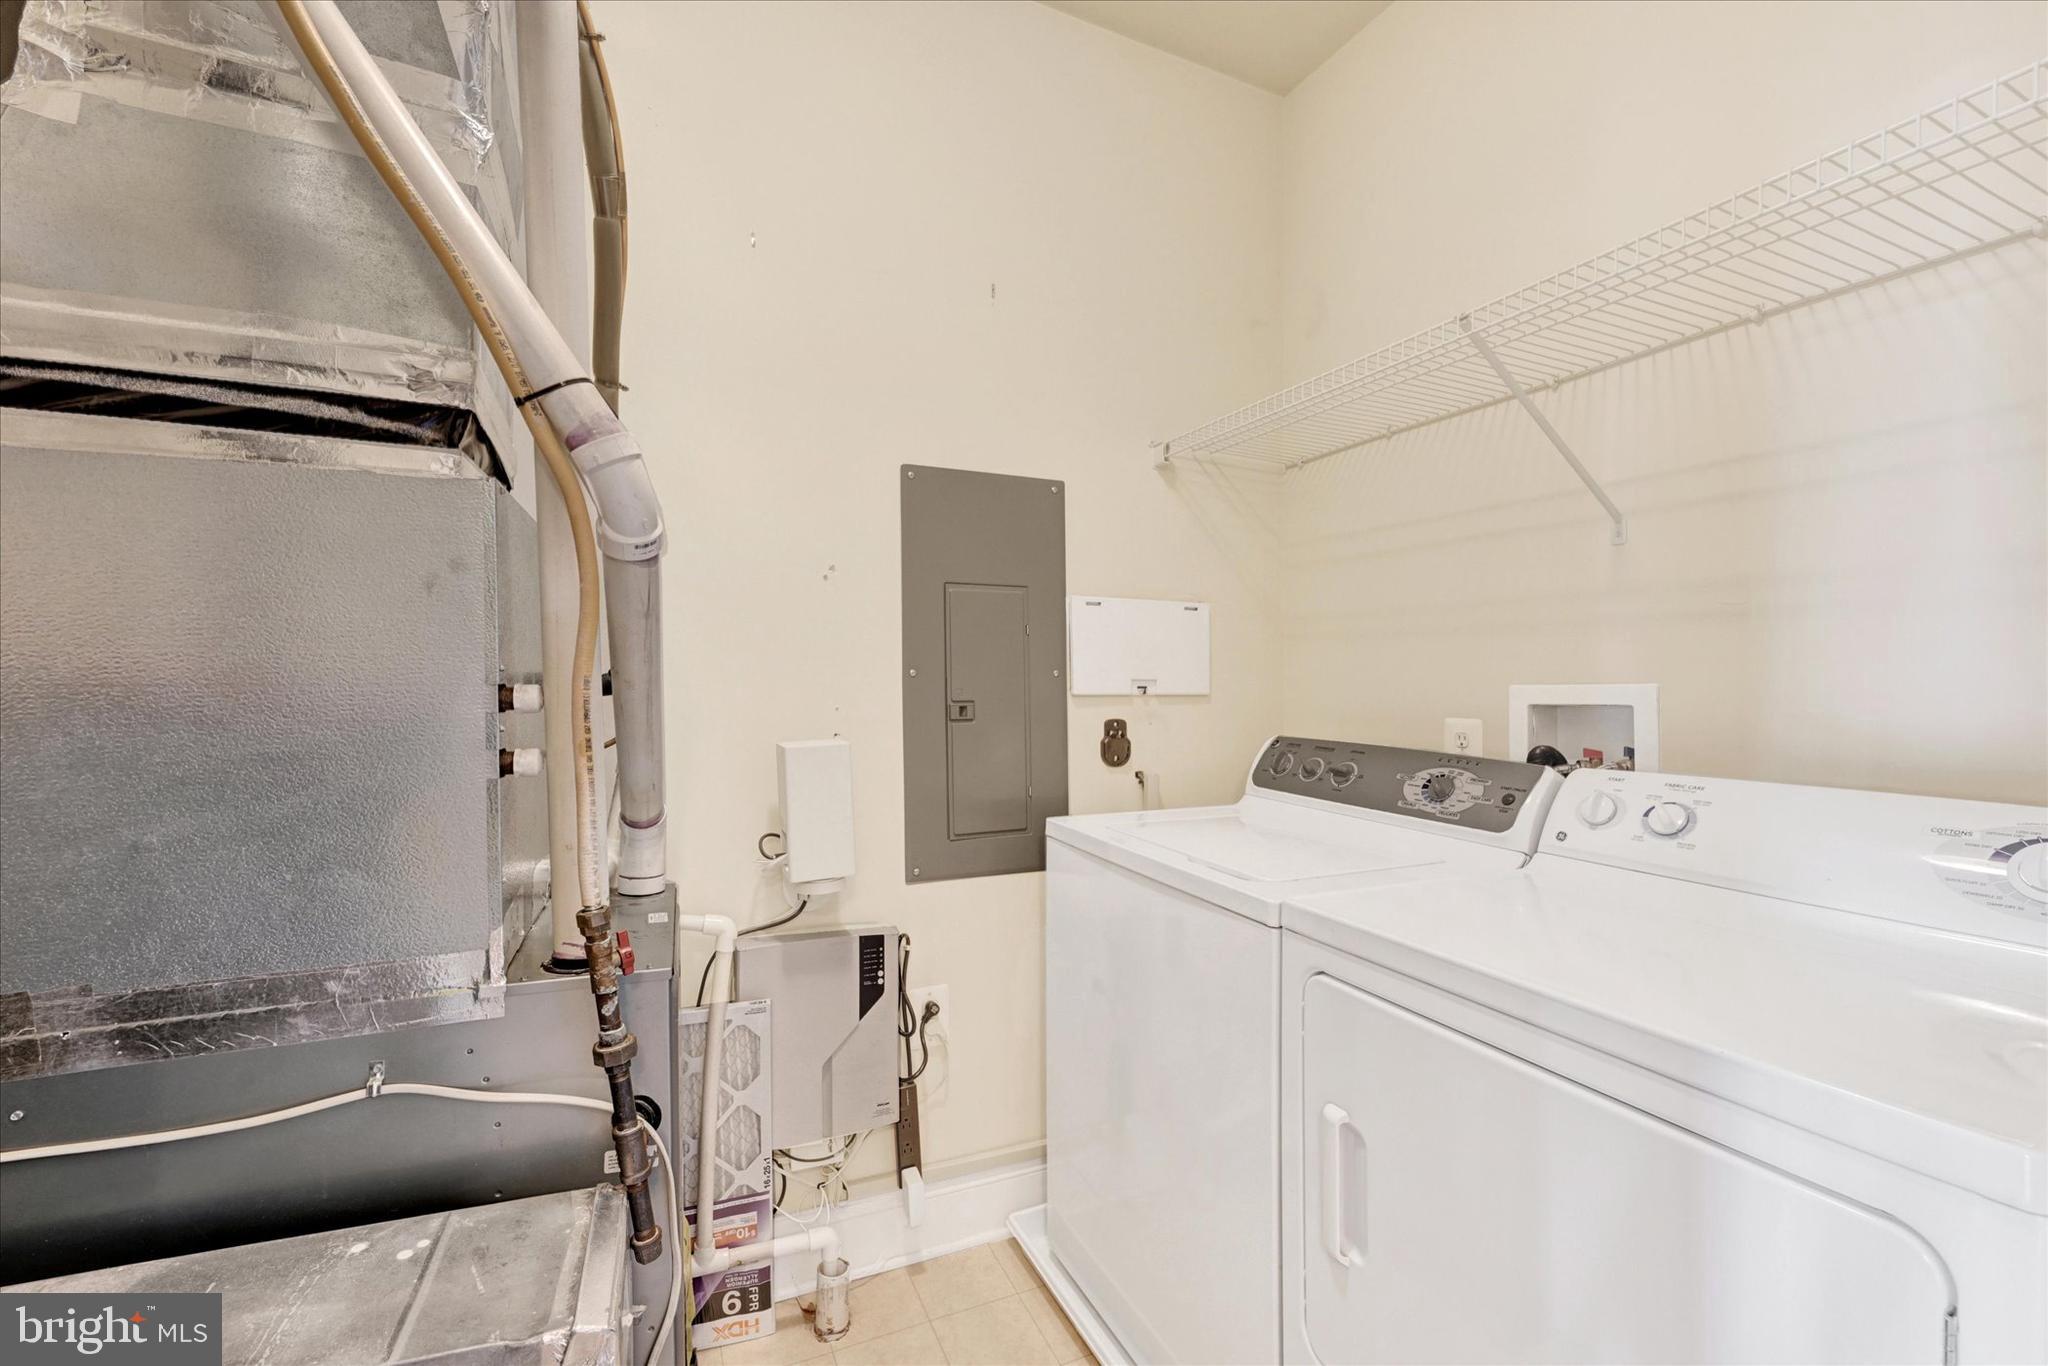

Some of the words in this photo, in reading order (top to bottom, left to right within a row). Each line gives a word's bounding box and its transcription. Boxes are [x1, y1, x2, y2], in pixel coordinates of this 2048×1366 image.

[1930, 827, 1974, 837] COTTONS
[749, 1287, 759, 1311] FPR
[712, 1318, 760, 1342] HDX
